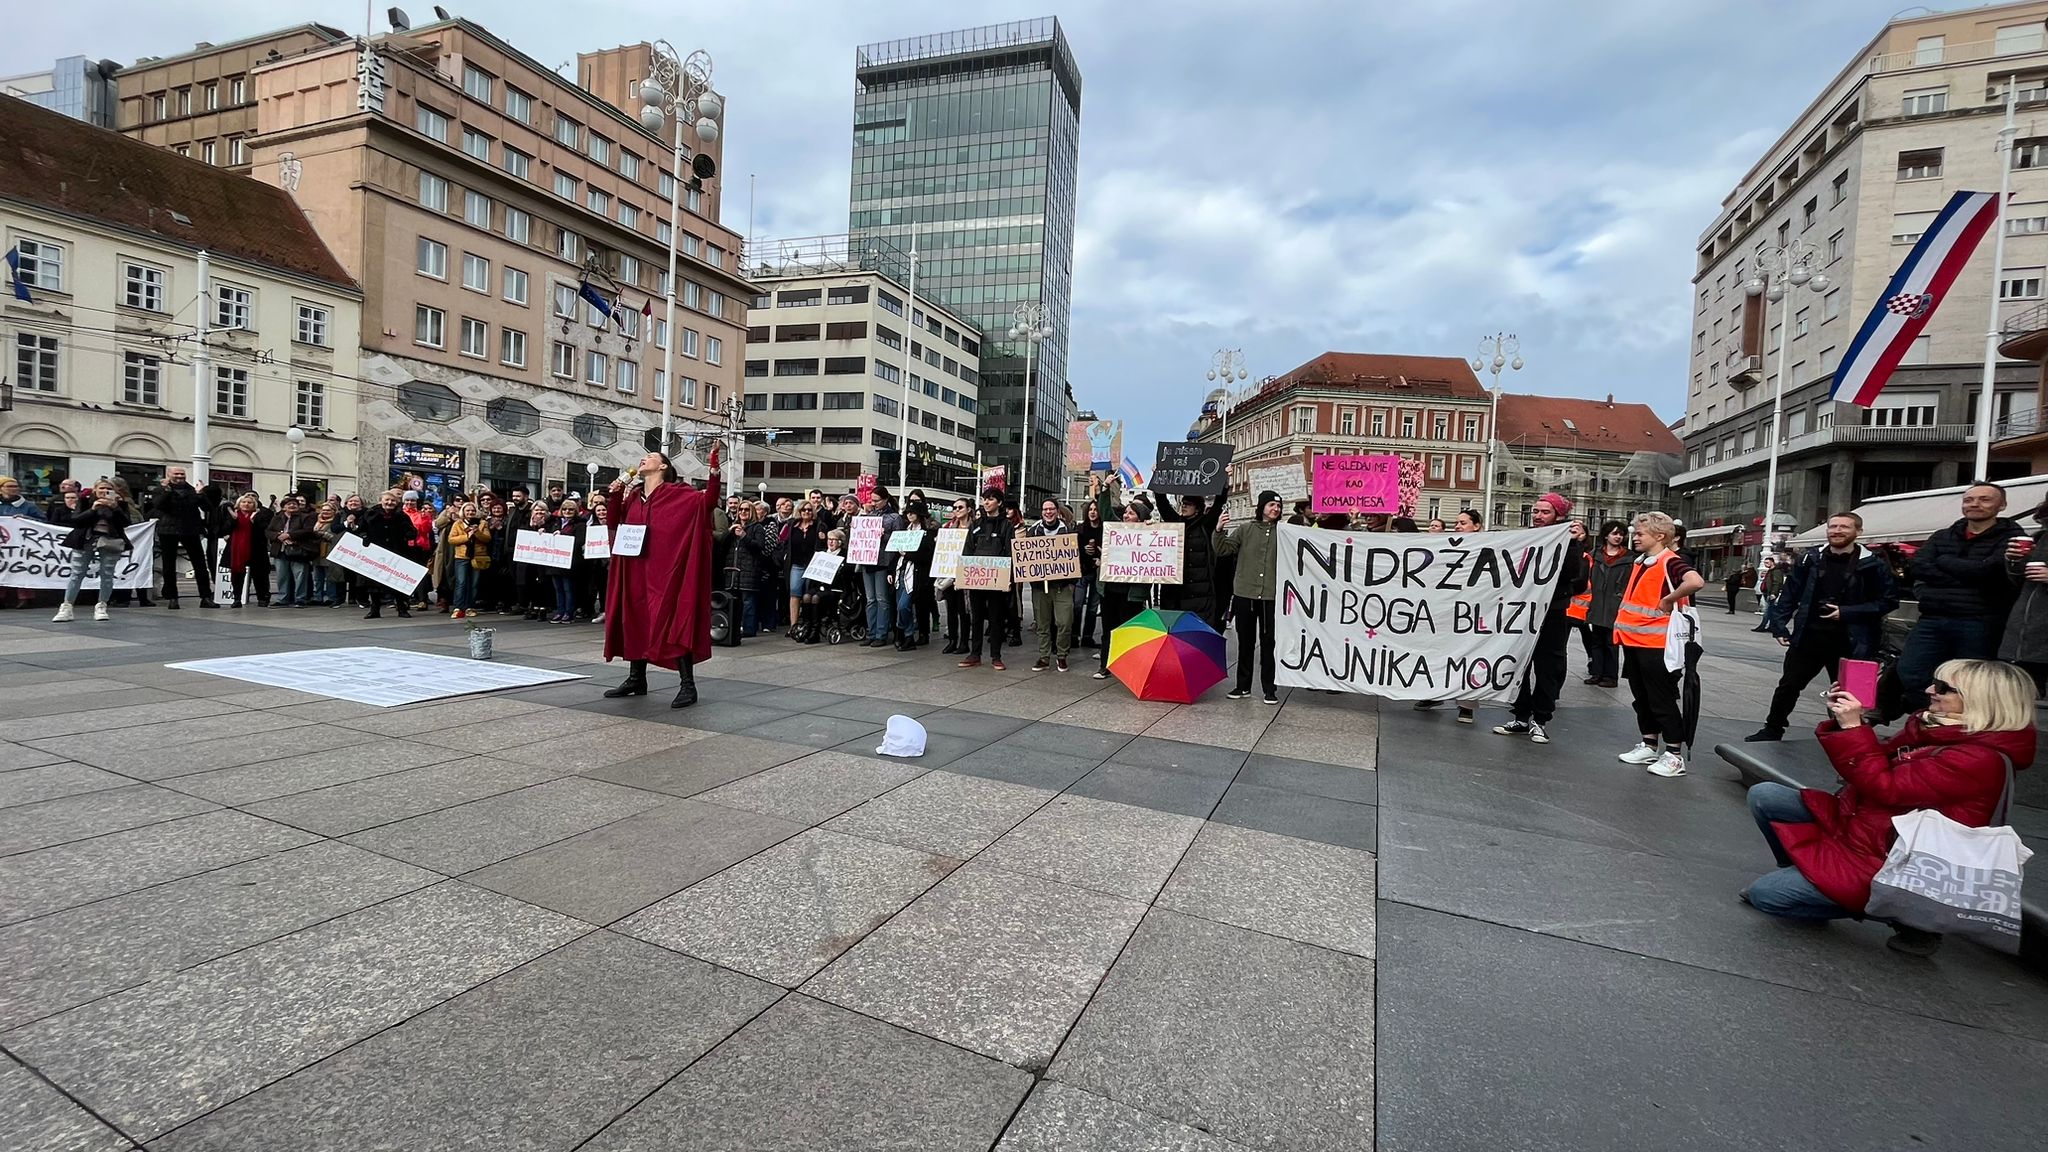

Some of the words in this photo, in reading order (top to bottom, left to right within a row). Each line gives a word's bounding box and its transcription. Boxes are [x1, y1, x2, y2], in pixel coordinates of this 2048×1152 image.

[1174, 445, 1203, 456] nisam
[1322, 461, 1335, 471] NE
[1338, 460, 1371, 471] GLEDAJ
[1374, 462, 1388, 472] ME
[1345, 479, 1363, 488] KAO
[1322, 496, 1355, 507] KOMAD
[1355, 496, 1385, 508] MESA
[861, 518, 882, 529] CRKVI
[1062, 537, 1069, 547] U
[1109, 530, 1142, 546] PRAVE
[1149, 530, 1176, 547] ŽENE
[1016, 548, 1079, 563] RAZMIŠLJANJU
[1131, 550, 1162, 563] NOSE
[1015, 565, 1027, 578] NE
[1029, 562, 1075, 578] ODIJEVANJU
[1364, 537, 1562, 591] DRŽAVU
[964, 567, 999, 578] SPASITI
[1107, 564, 1176, 577] TRANSPARENTE
[1340, 590, 1436, 635] BOGA
